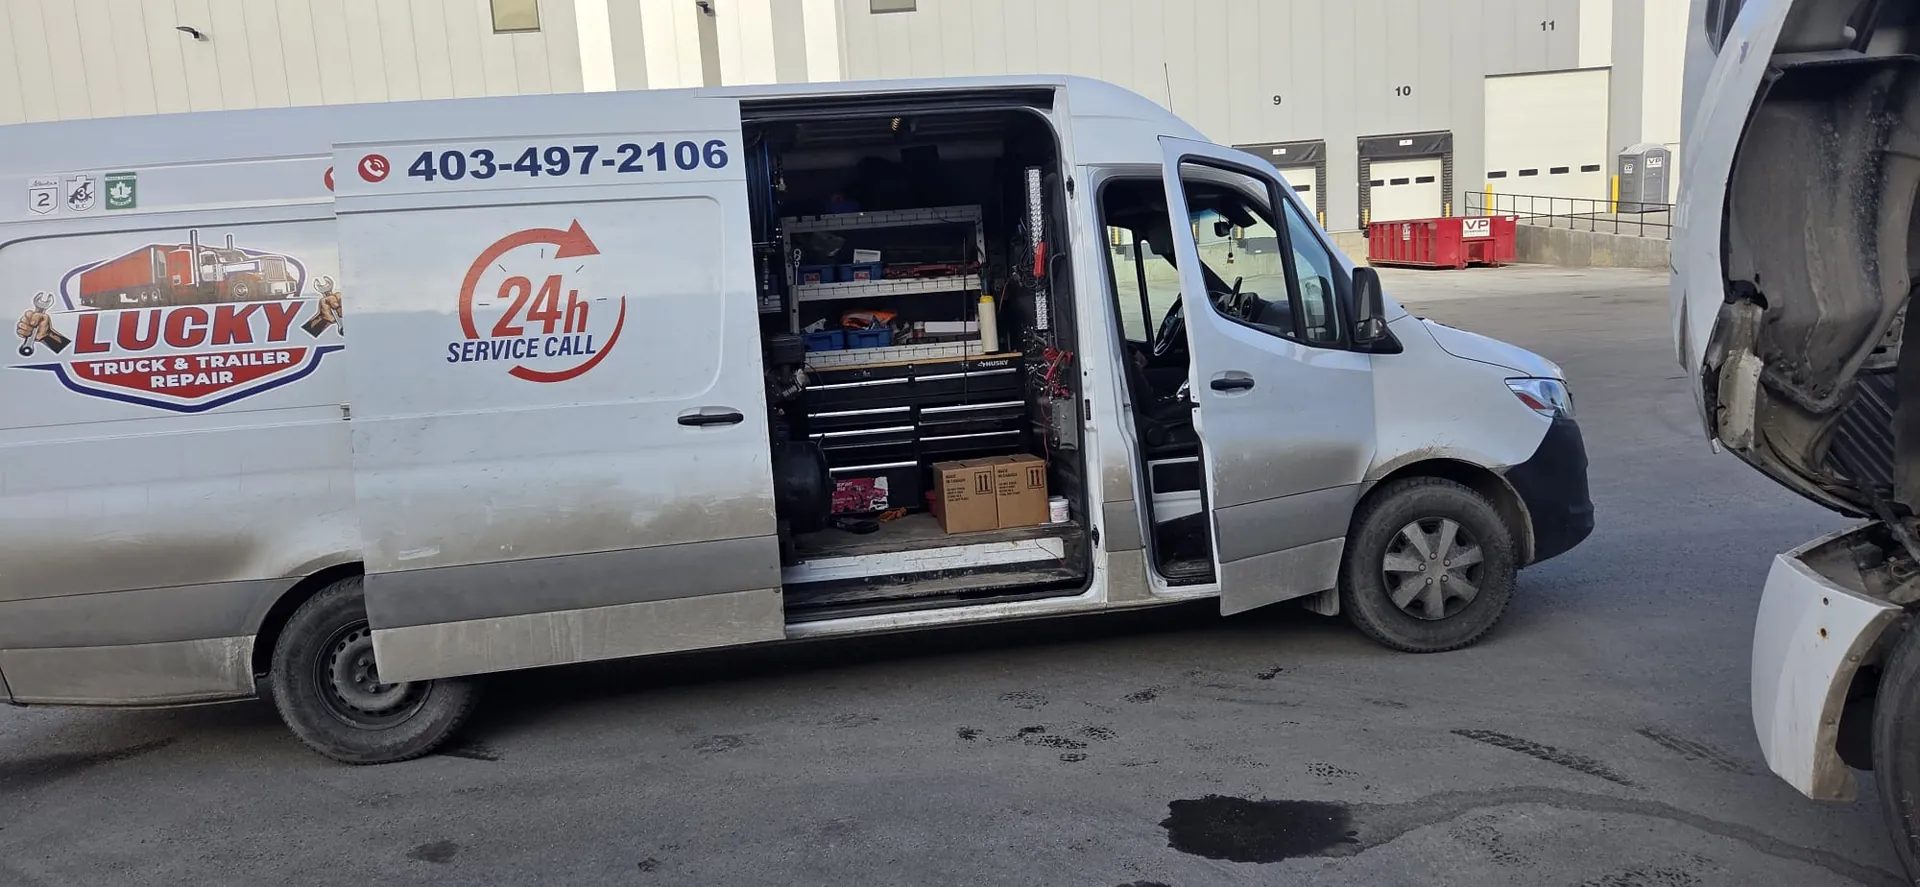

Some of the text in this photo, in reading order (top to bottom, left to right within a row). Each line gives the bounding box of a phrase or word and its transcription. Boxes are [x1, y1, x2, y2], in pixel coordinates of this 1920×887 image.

[1541, 20, 1555, 31] 11
[1395, 85, 1411, 96] 10
[1273, 95, 1281, 105] 9
[407, 139, 728, 182] 403-497-2106
[37, 192, 50, 207] 2
[76, 187, 86, 200] 3
[1465, 220, 1489, 229] VP
[491, 274, 590, 338] 24h
[74, 301, 304, 354] LUCKY
[446, 334, 597, 363] SERVICE CALL
[90, 351, 291, 376] TRUCK & TRAILER
[985, 359, 1008, 367] HUSKY
[150, 370, 233, 388] REPAIR
